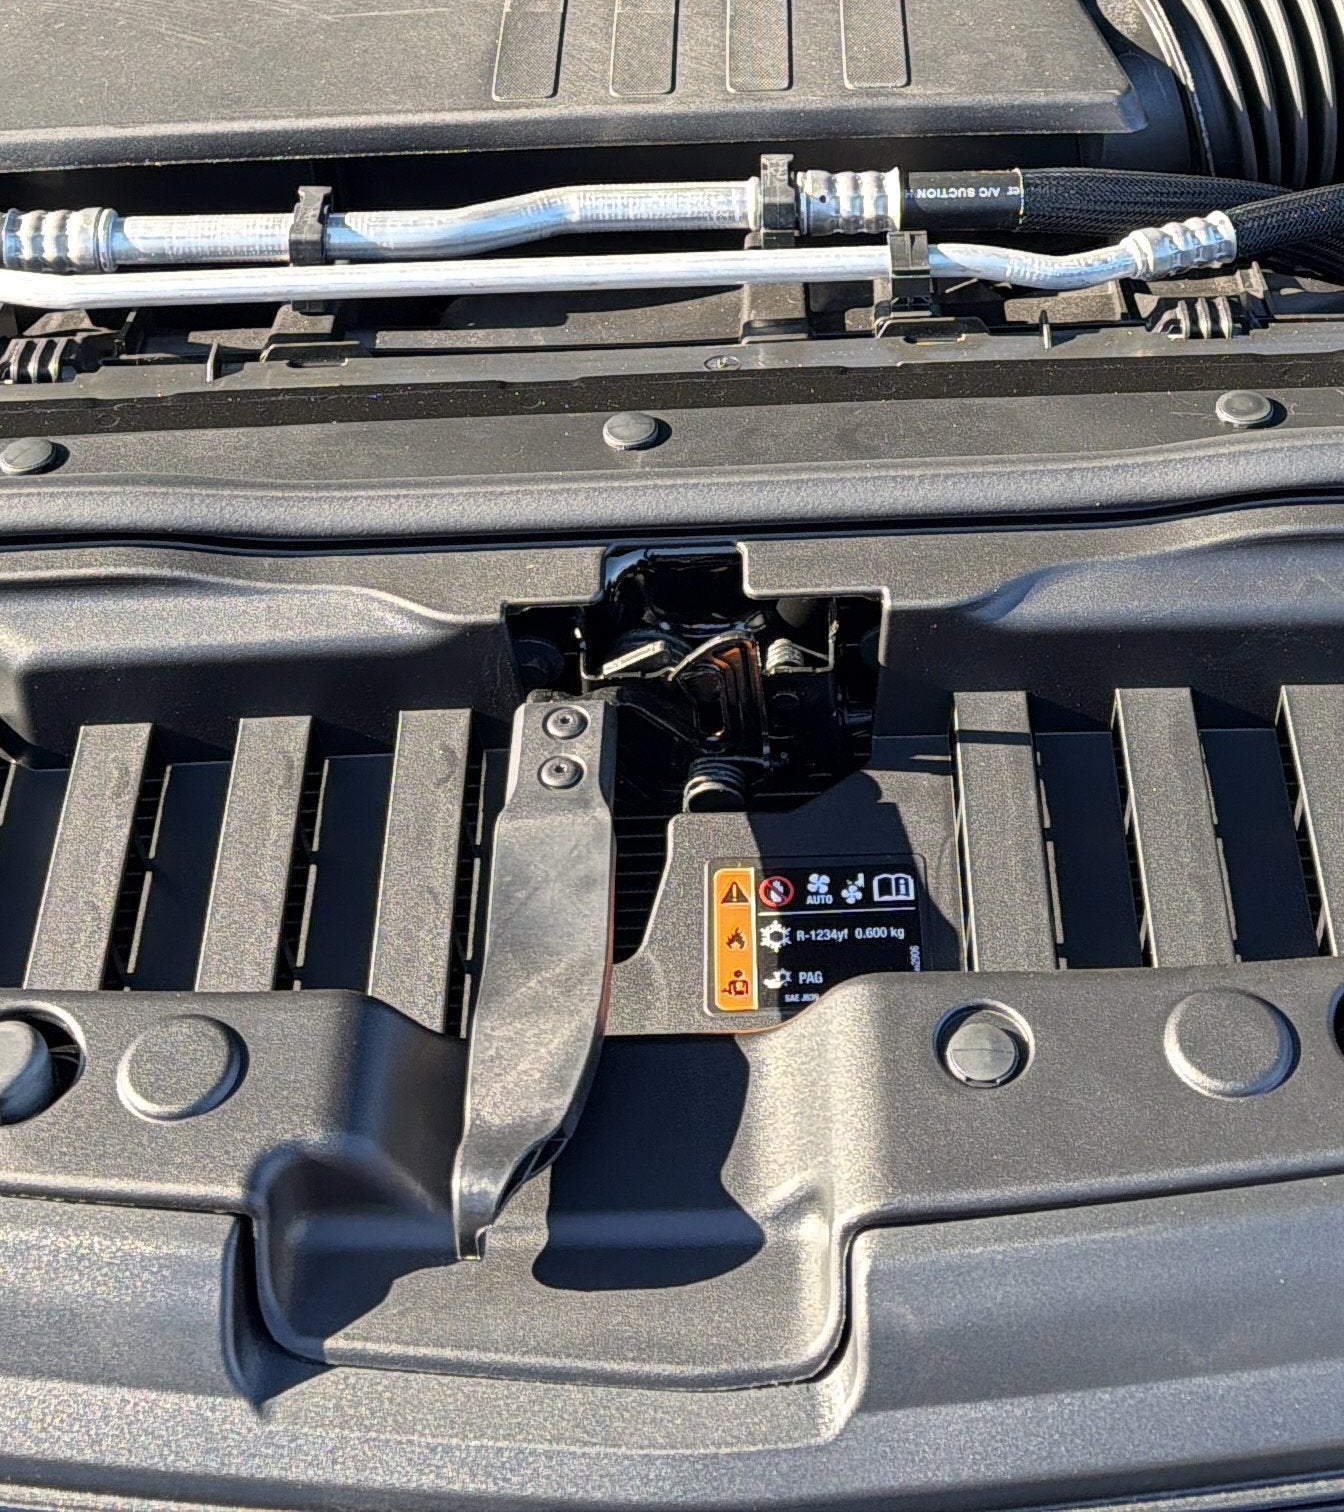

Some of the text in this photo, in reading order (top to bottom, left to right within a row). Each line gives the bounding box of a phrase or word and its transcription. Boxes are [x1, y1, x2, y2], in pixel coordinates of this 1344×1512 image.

[916, 187, 976, 199] SUCTION
[978, 187, 1001, 198] A/C
[806, 894, 834, 905] AUTO
[796, 927, 905, 942] R-1234yf 0.600 kg
[798, 971, 824, 984] PAG
[784, 993, 800, 1002] SAE
